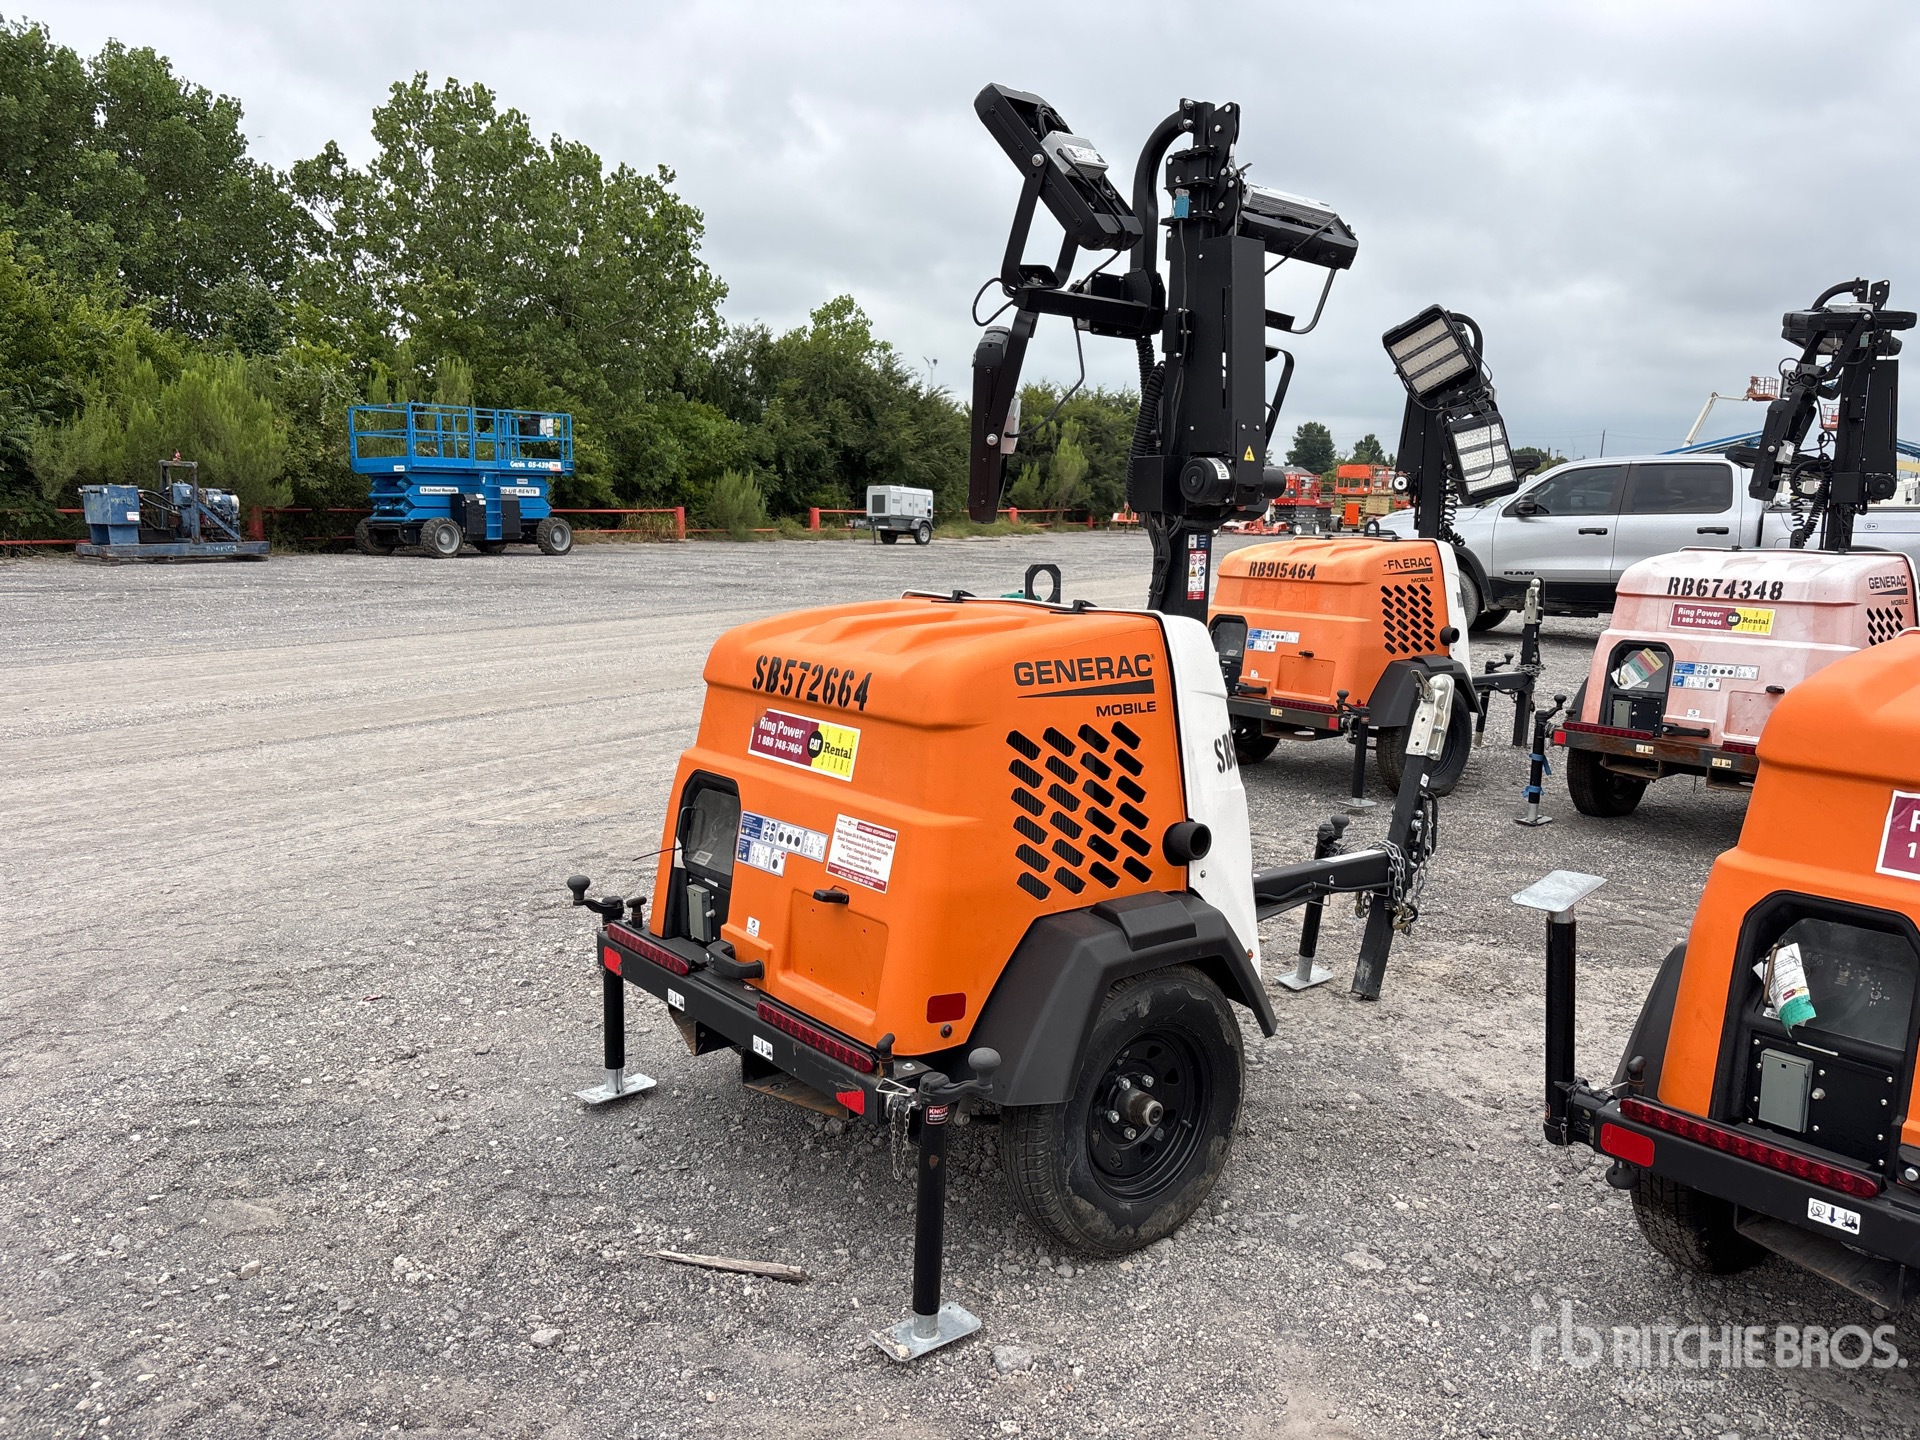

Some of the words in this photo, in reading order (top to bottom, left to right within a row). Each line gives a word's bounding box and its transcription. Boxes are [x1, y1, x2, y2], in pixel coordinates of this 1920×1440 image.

[1248, 562, 1317, 580] RB915464
[1667, 576, 1784, 600] RB674348
[1868, 574, 1907, 590] GENERAC
[1678, 607, 1695, 618] Ring
[1696, 608, 1722, 618] Power
[1742, 616, 1769, 624] Rental
[1014, 654, 1152, 686] GENERAC
[752, 654, 872, 712] SB572664
[1096, 700, 1156, 718] MOBILE
[760, 716, 776, 736] Ring
[777, 720, 803, 739] Power
[762, 736, 774, 747] 888
[774, 738, 802, 755] 748-7464
[809, 738, 822, 752] CAT
[823, 742, 852, 760] Rental
[1908, 842, 1917, 858] 1
